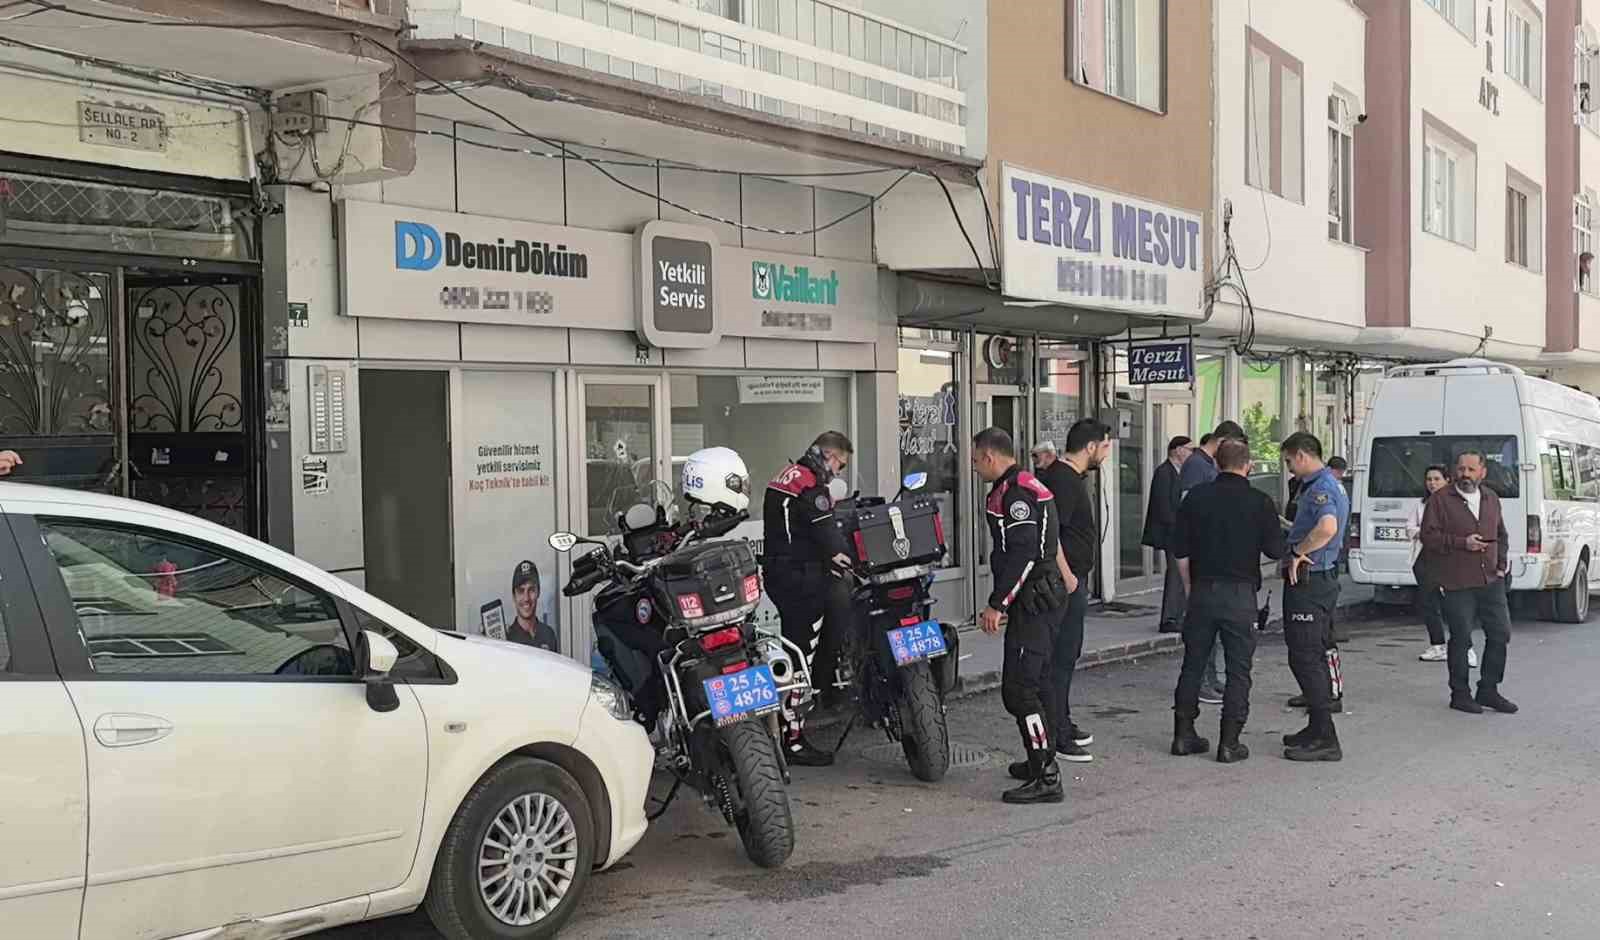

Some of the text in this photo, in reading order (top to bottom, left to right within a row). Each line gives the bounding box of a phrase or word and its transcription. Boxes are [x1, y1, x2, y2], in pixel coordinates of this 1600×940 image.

[1010, 176, 1200, 272] TERZI MESUT
[445, 231, 588, 279] DemirDöküm
[658, 259, 706, 285] Yetkili
[770, 263, 839, 306] Vaillant
[659, 286, 706, 310] Servis
[1131, 346, 1184, 365] Terzi
[1130, 367, 1186, 384] Mesut
[478, 443, 540, 457] Güvenilir hizmet
[476, 459, 541, 476] yetkili servisimiz
[468, 479, 484, 492] Koç
[905, 625, 937, 641] 25 A
[911, 636, 942, 653] 4878
[728, 671, 768, 692] 25 A
[733, 685, 774, 707] 4876
